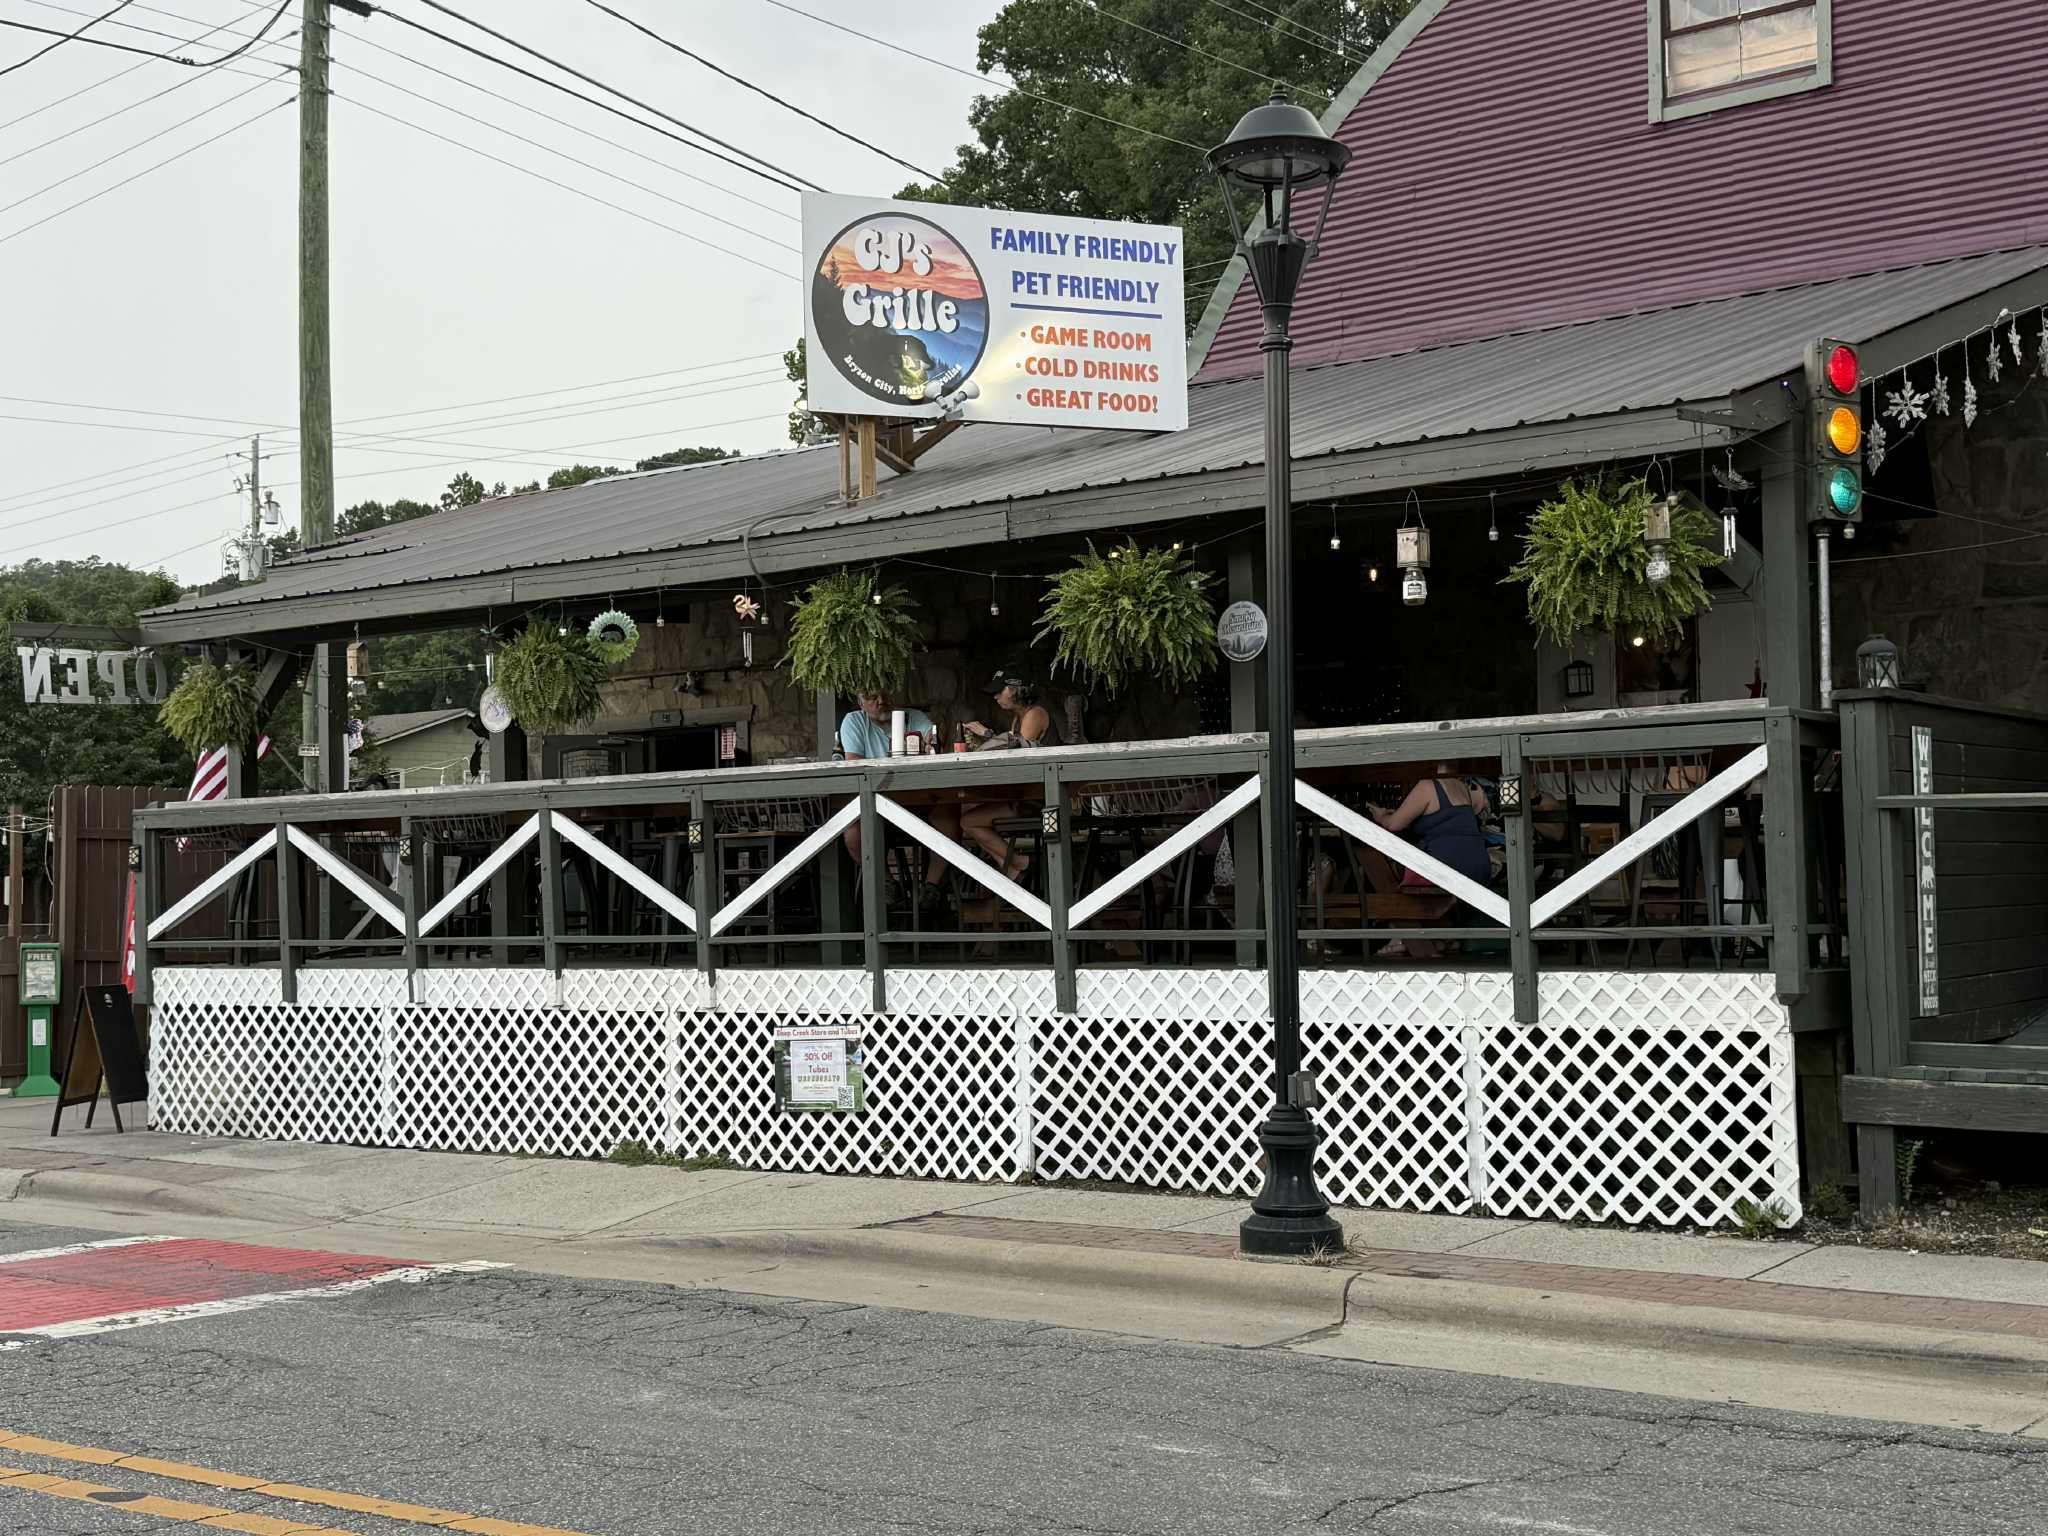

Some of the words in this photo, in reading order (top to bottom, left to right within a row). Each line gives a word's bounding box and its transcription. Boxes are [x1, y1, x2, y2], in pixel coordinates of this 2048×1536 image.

[991, 227, 1070, 256] FAMILY
[1074, 234, 1177, 265] FRIENDLY
[1012, 270, 1052, 296] PET
[1057, 274, 1160, 304] FRIENDLY
[842, 283, 960, 334] Grille
[1030, 325, 1088, 347] GAME
[1094, 329, 1152, 352] ROOM
[1025, 356, 1079, 378] COLD
[1083, 360, 1159, 383] DRINKS
[874, 378, 896, 395] City,
[899, 384, 927, 397] Nort
[1026, 387, 1093, 410] GREAT
[1098, 391, 1159, 414] FOOD!
[27, 952, 54, 961] FREE
[811, 1027, 827, 1036] Store
[808, 1064, 829, 1073] Tubes
